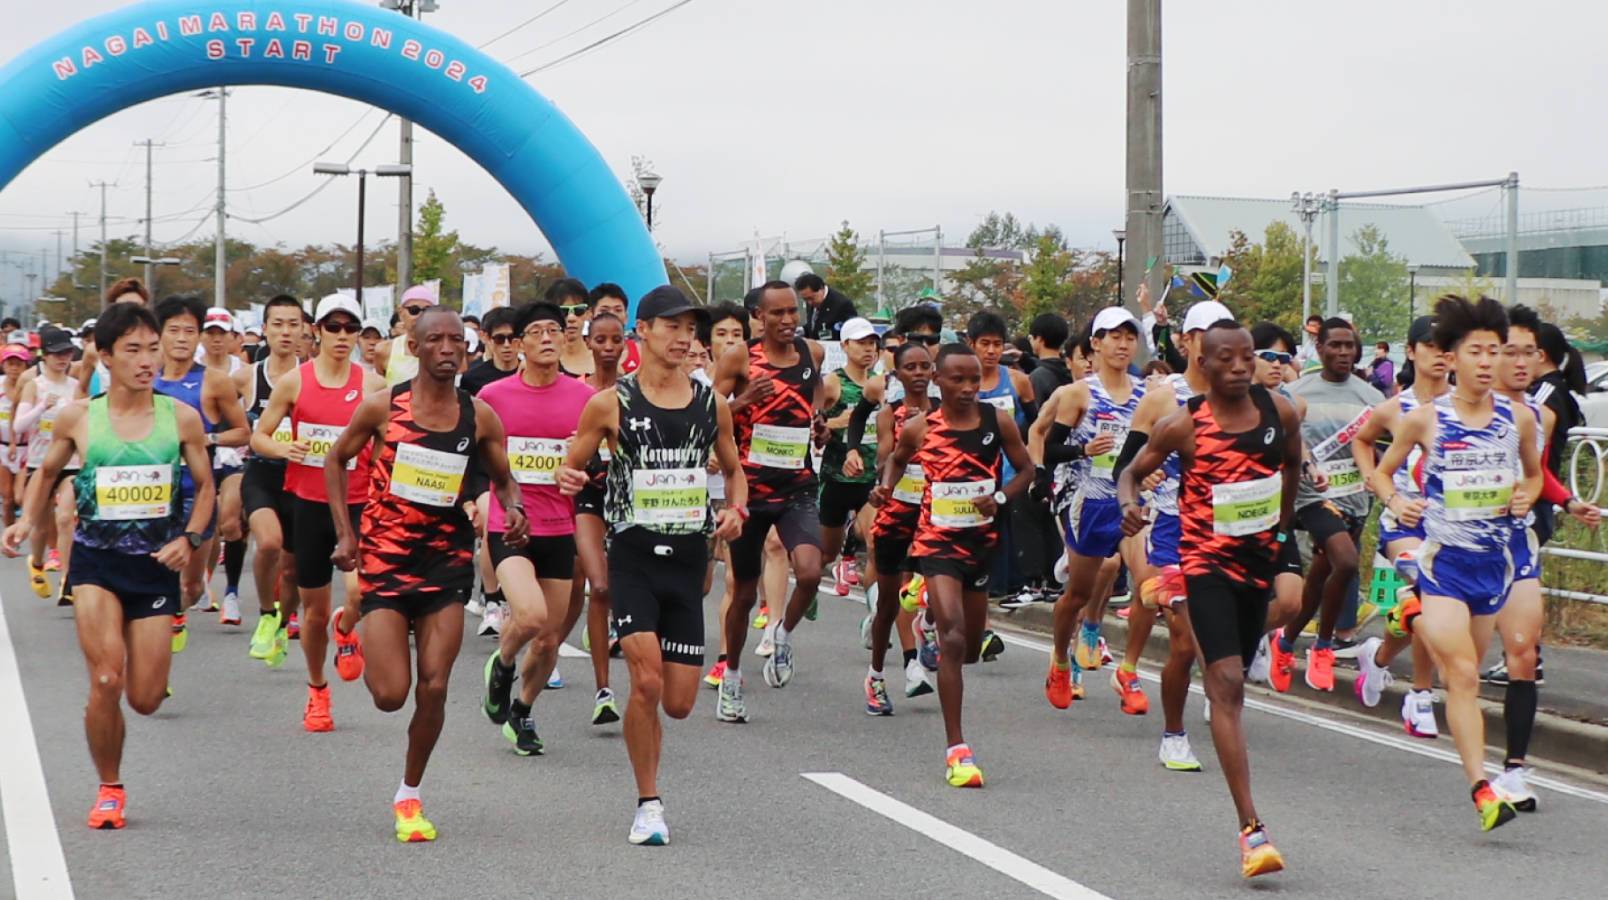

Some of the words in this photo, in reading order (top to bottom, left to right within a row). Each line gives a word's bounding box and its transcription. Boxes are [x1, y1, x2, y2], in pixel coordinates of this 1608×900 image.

[52, 20, 169, 81] NAGAI
[178, 11, 392, 49] MARATHON
[401, 38, 489, 94] 2024
[206, 38, 342, 64] START
[514, 455, 563, 470] 42001
[1451, 451, 1507, 466] 帝京大学
[415, 476, 446, 490] NAASI
[106, 485, 164, 502] 40002
[1237, 506, 1269, 519] NDEGE
